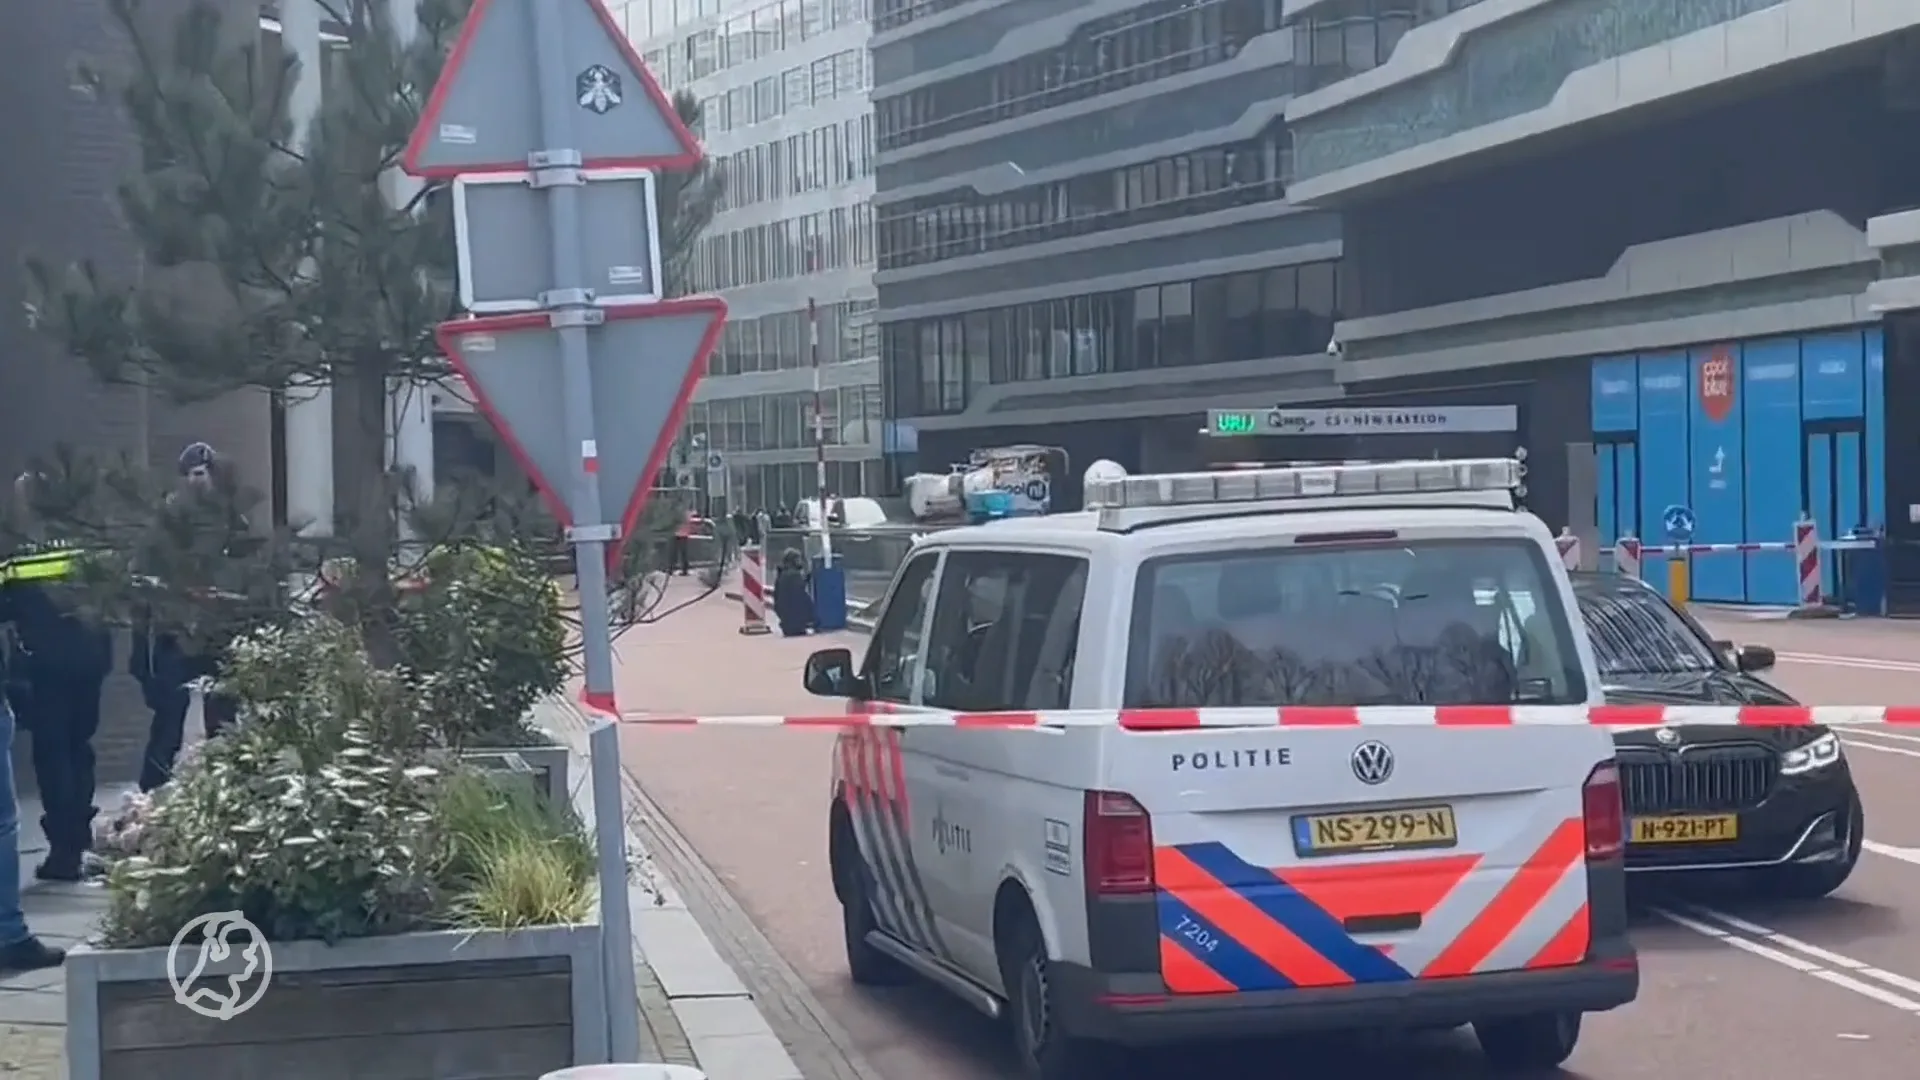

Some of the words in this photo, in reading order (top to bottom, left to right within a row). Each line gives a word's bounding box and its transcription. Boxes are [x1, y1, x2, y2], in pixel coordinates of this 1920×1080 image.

[1171, 747, 1293, 771] POLITIE
[1316, 810, 1447, 843] NS-299-N
[1641, 816, 1730, 840] N-921-PT
[1174, 913, 1219, 952] 7204
